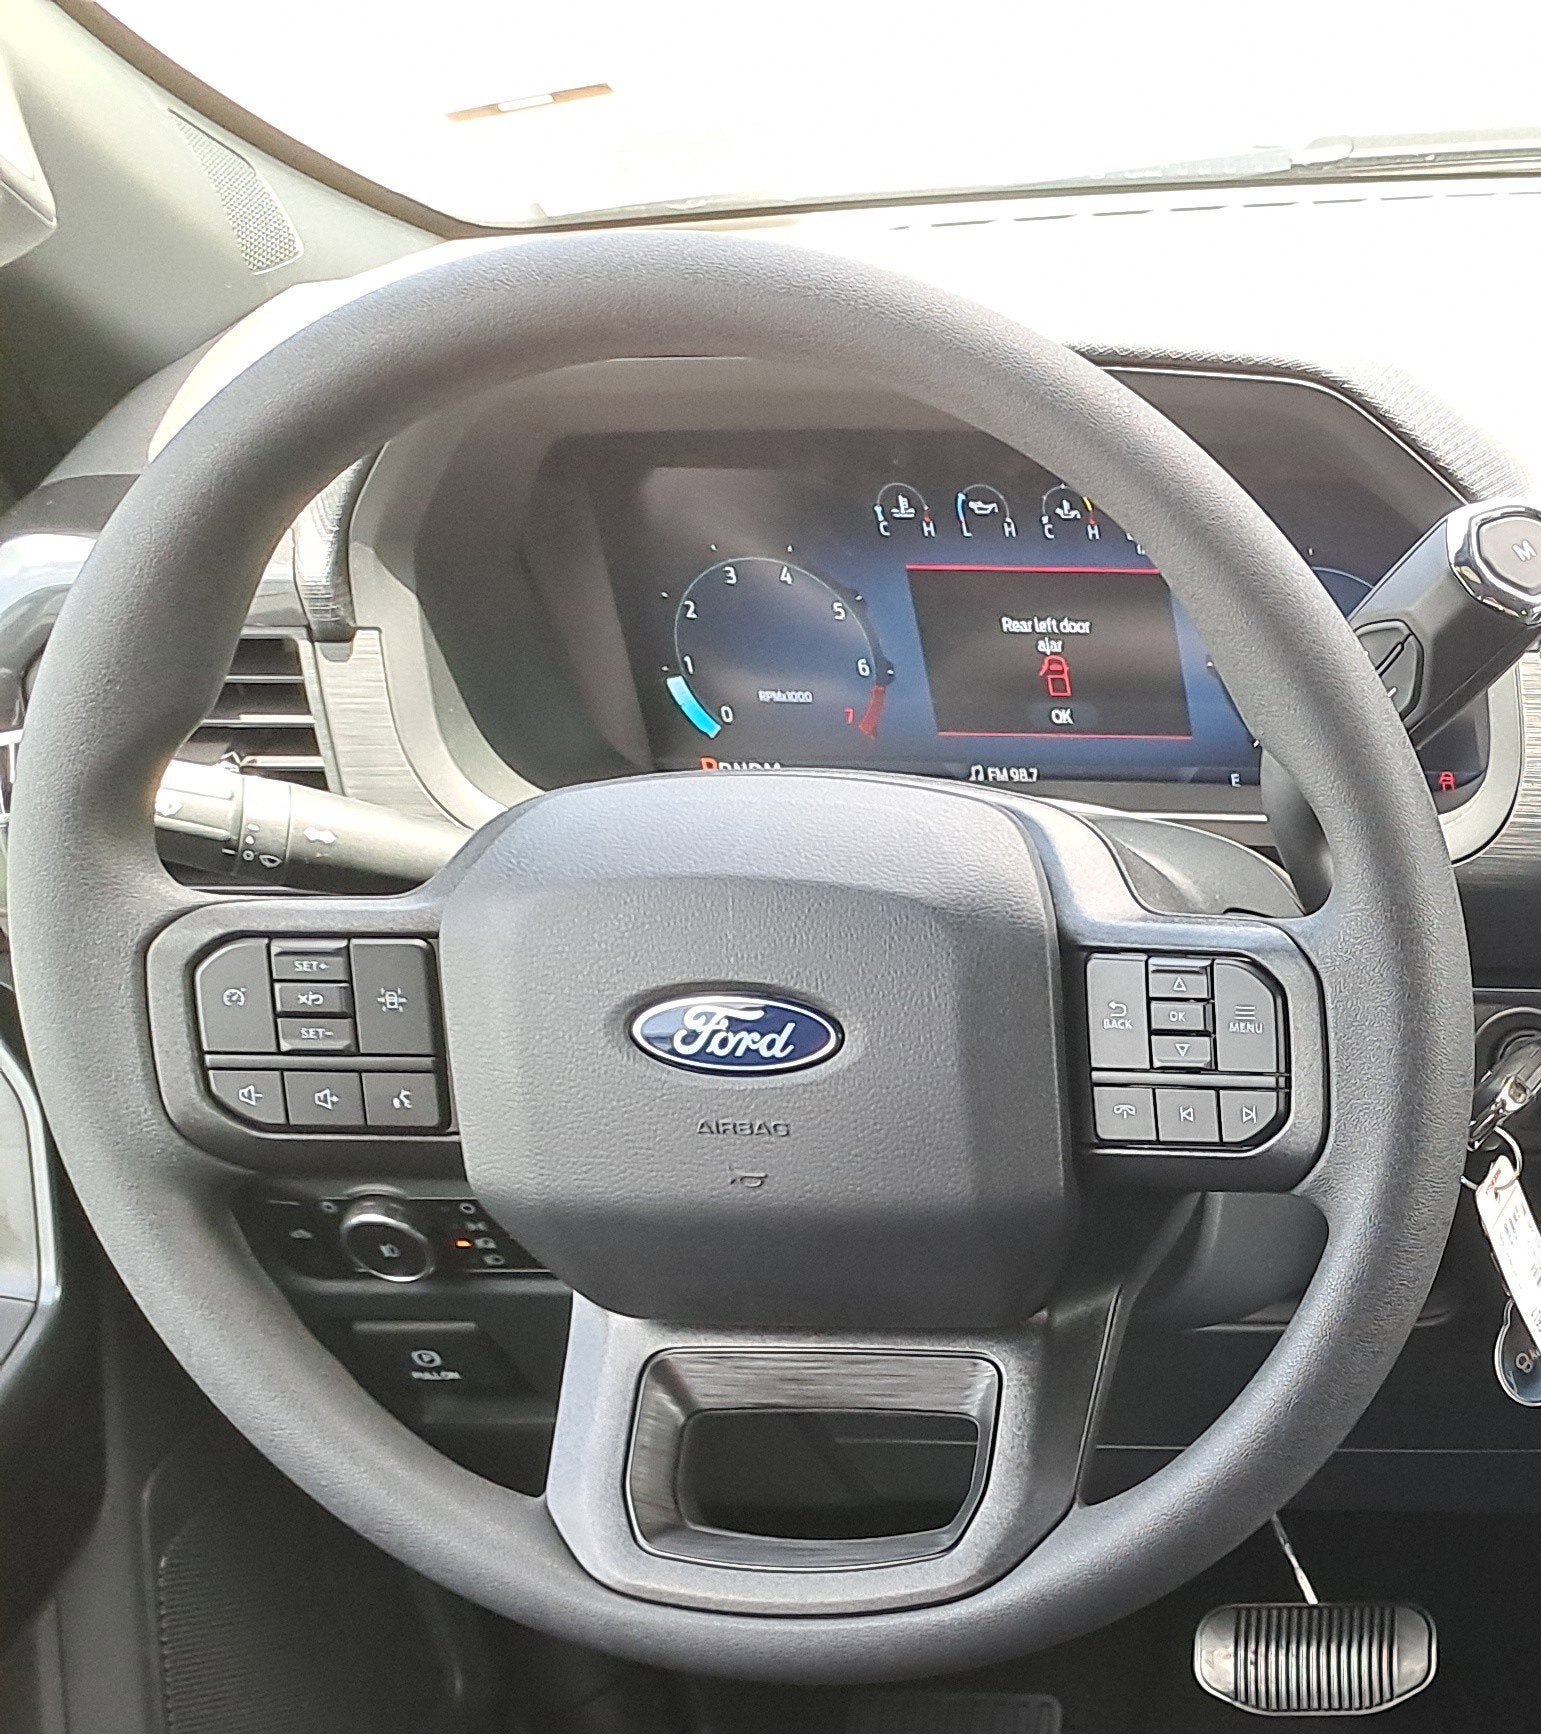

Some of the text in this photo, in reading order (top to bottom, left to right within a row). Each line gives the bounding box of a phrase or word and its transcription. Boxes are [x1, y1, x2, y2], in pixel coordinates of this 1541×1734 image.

[923, 521, 935, 537] H
[1004, 521, 1016, 538] H
[1088, 524, 1100, 540] H
[1511, 539, 1537, 562] M
[724, 566, 737, 585] 3
[779, 566, 793, 585] 4
[684, 601, 698, 619] 2
[832, 601, 846, 621] 5
[1001, 616, 1091, 635] Rear left door
[1037, 637, 1064, 655] ajar
[683, 655, 694, 675] 1
[857, 658, 870, 677] 6
[843, 707, 855, 725] 7
[1050, 708, 1074, 725] OK
[987, 767, 1039, 783] FM 98.7
[1230, 773, 1241, 788] E
[1103, 1018, 1134, 1031] BACK
[1169, 1011, 1187, 1023] OK
[672, 1003, 797, 1059] Ford
[1228, 1021, 1264, 1035] MENU
[696, 1117, 791, 1138] AIRBAG
